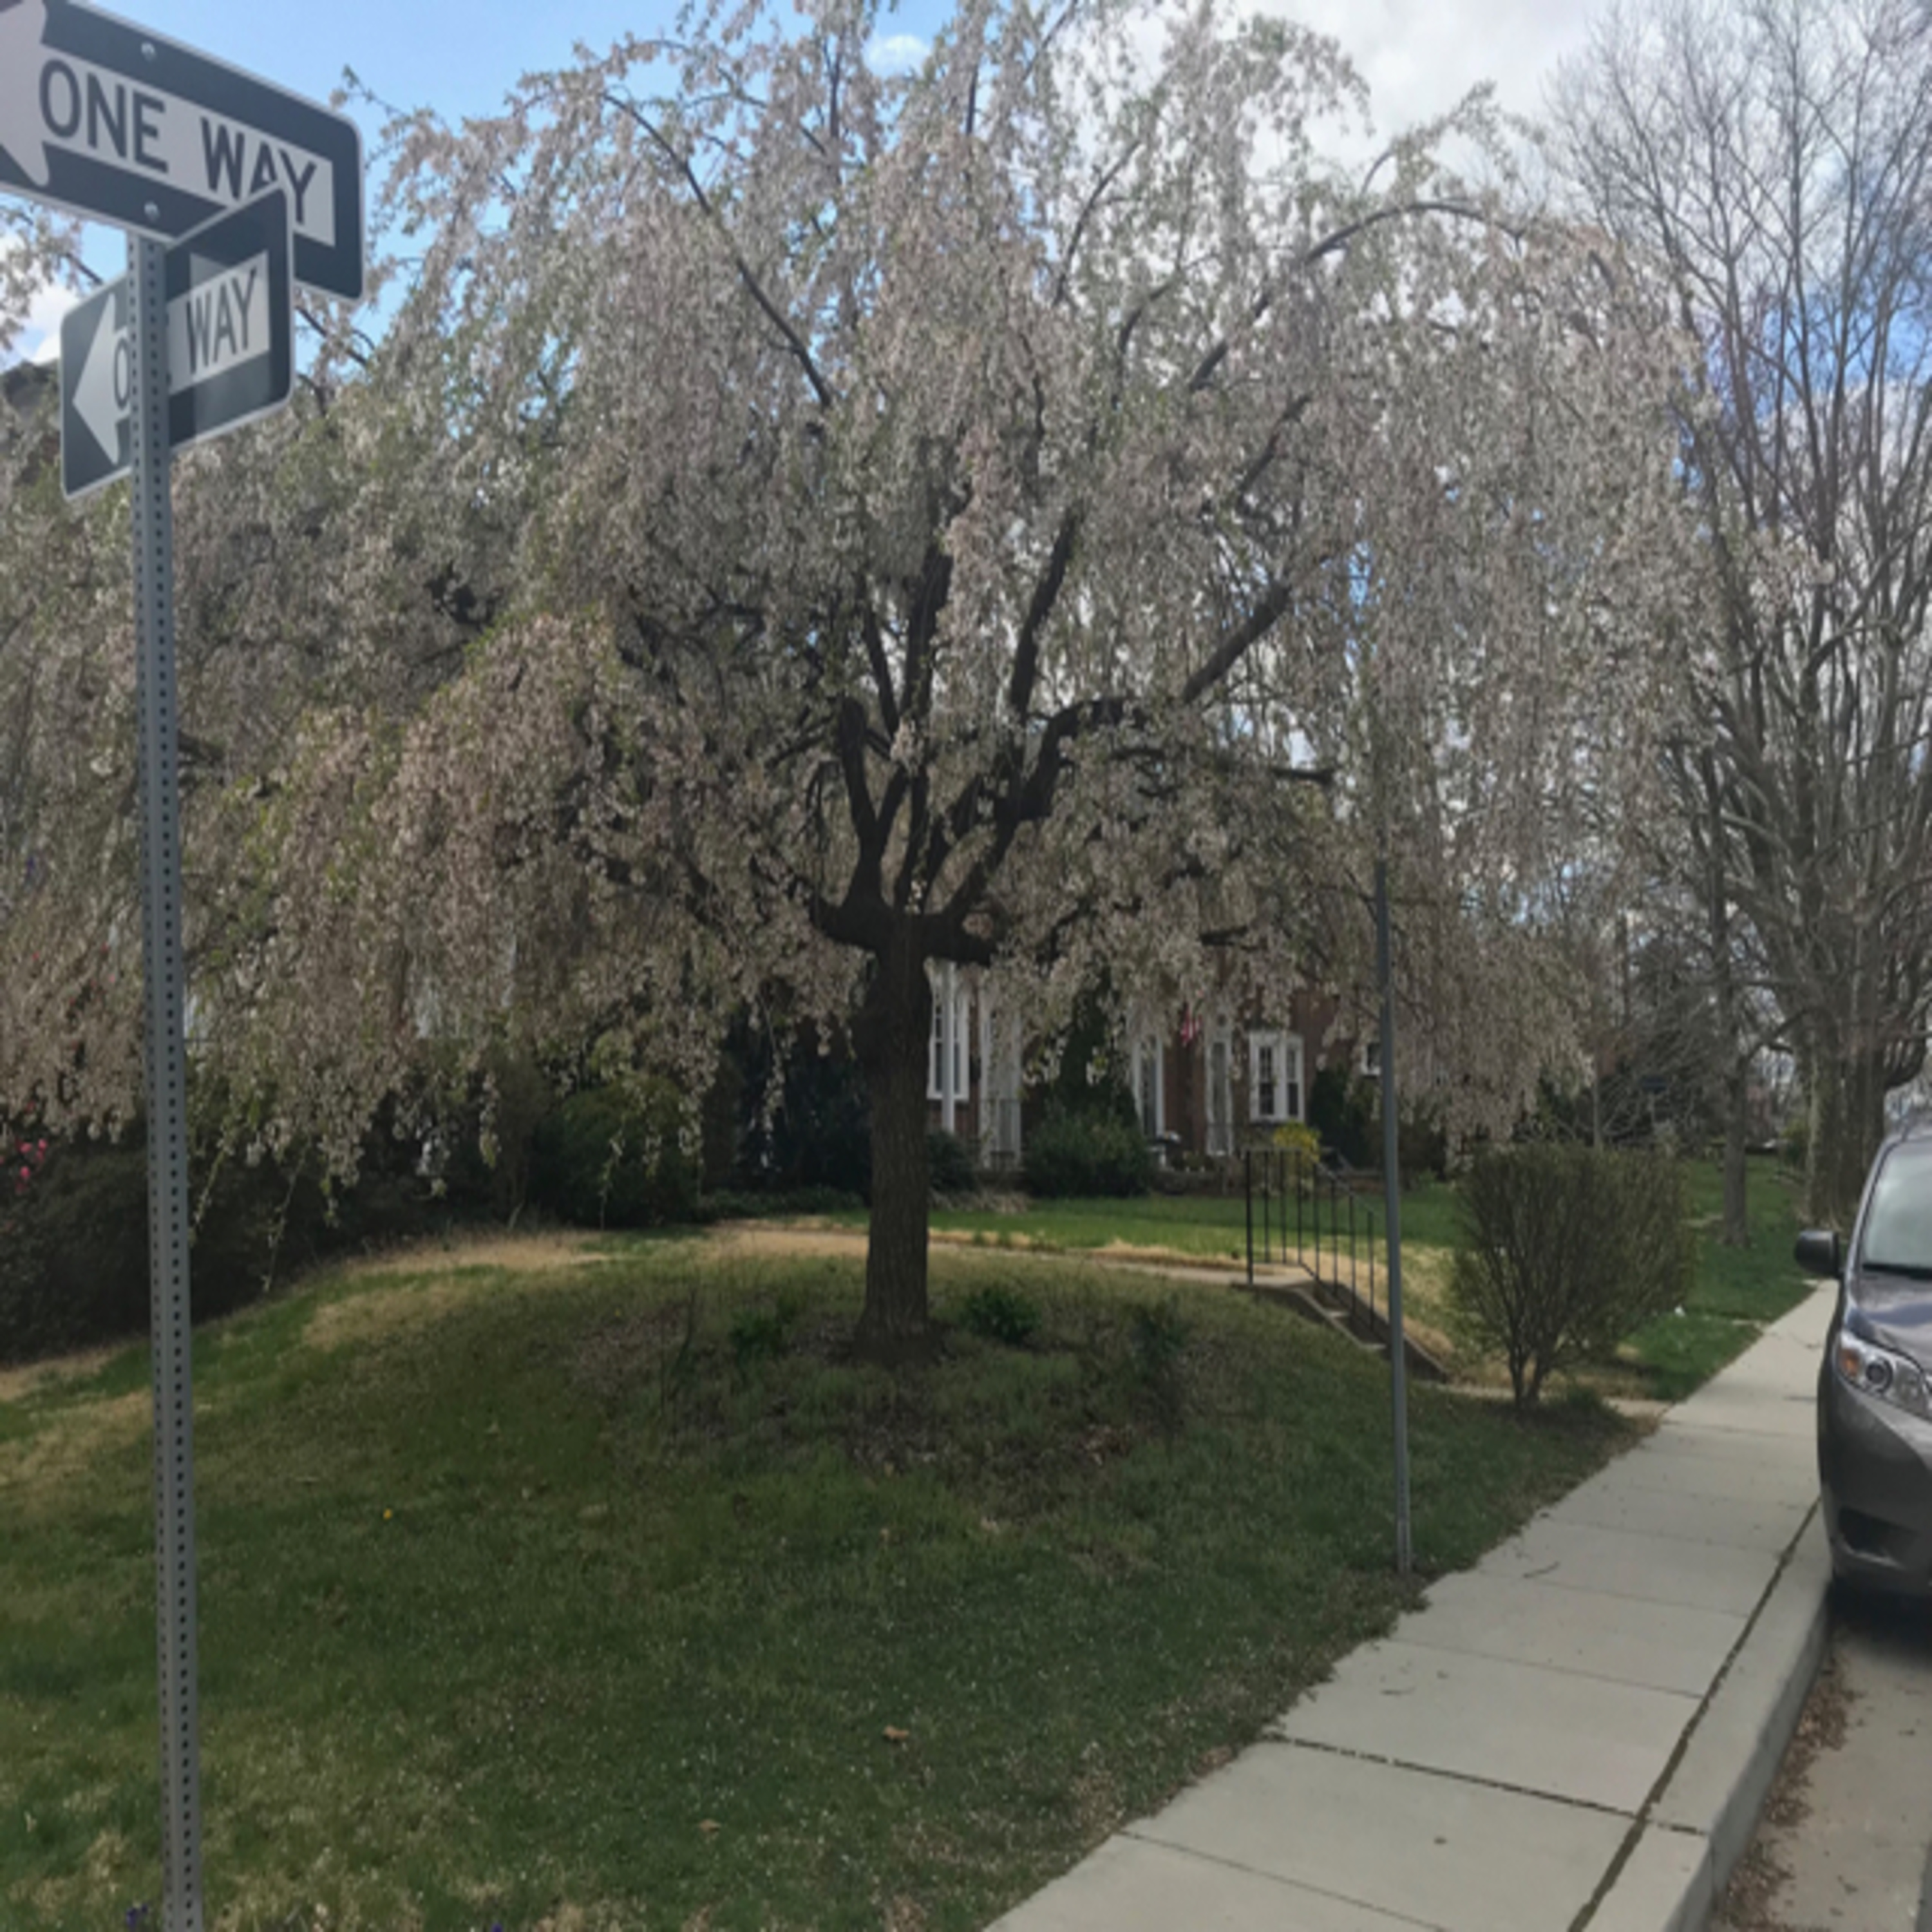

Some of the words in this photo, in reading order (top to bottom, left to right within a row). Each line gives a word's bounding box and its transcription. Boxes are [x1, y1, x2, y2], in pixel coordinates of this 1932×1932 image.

[39, 59, 168, 173] ONE
[200, 116, 317, 225] WAY
[185, 267, 256, 375] WAY
